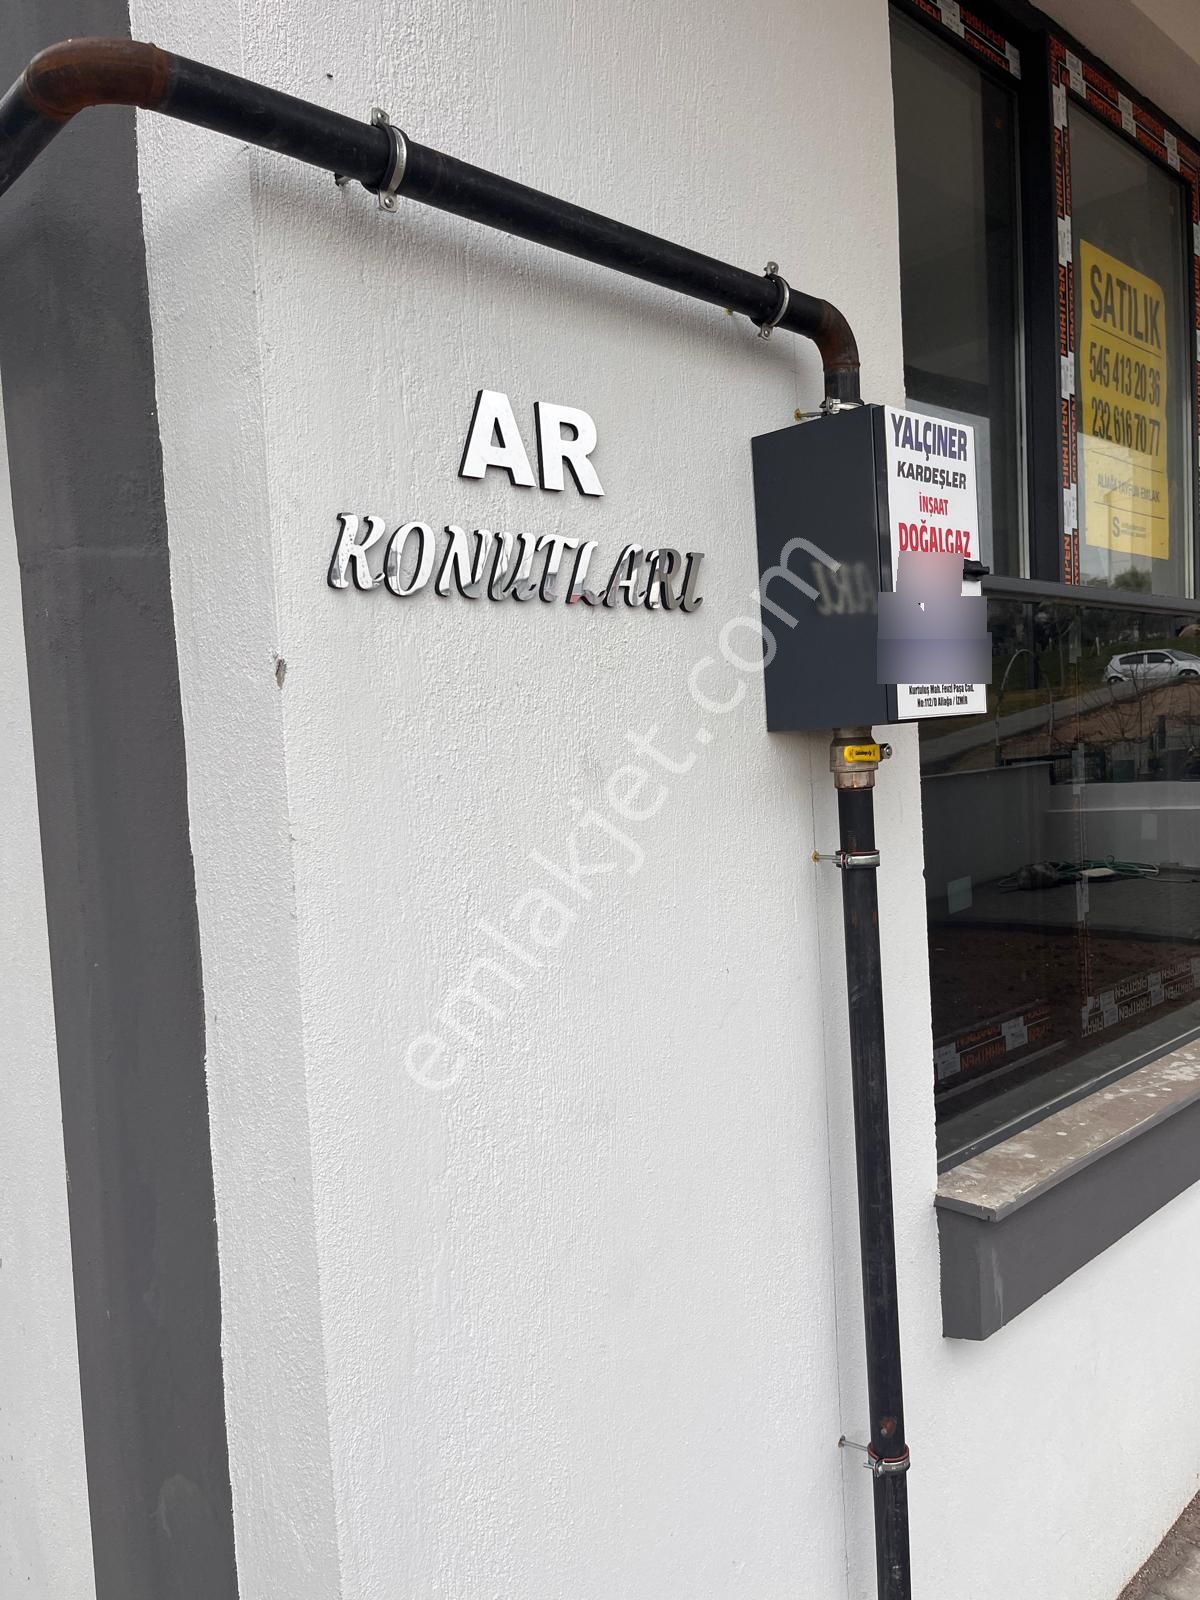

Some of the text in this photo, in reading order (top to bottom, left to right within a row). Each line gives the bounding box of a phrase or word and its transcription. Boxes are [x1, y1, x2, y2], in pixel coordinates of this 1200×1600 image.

[1089, 264, 1162, 350] SATILIK
[1089, 341, 1111, 388] 545
[1112, 352, 1132, 396] 413
[1134, 361, 1147, 402] 20
[1148, 367, 1161, 407] 36
[458, 389, 605, 497] AR
[891, 413, 968, 462] YALÇINER
[1091, 396, 1112, 441] 232
[1113, 405, 1133, 448] 616
[1134, 412, 1147, 453] 70
[1148, 418, 1161, 456] 77
[897, 460, 967, 489] KARDEŞLER
[919, 492, 948, 517] İNŞAAT
[327, 512, 705, 613] KONUTLARI
[898, 519, 971, 558] DOĞALGAZ
